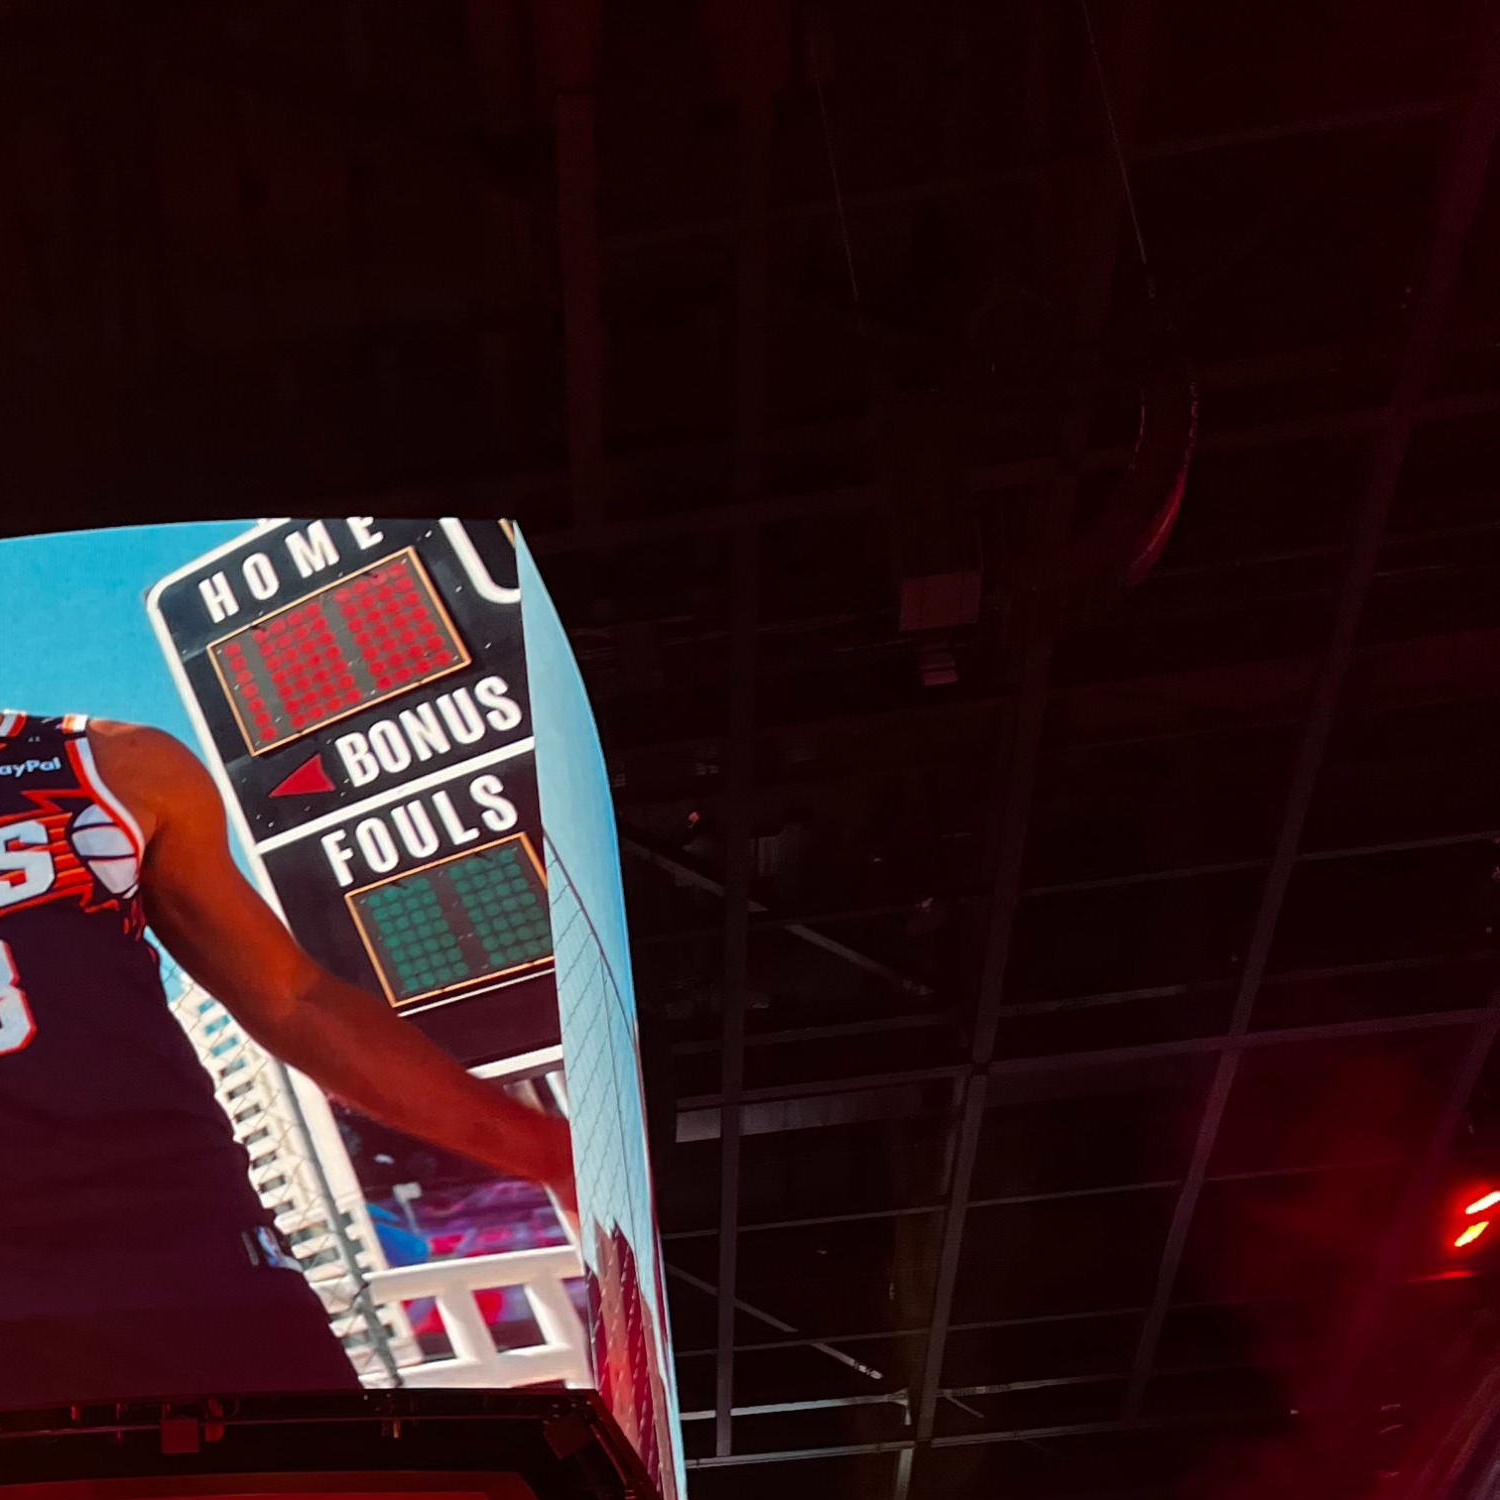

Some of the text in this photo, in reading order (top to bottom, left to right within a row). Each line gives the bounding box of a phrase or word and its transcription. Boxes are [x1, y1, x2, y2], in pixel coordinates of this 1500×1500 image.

[199, 517, 385, 623] HOME
[334, 676, 523, 788] BONUS
[321, 774, 518, 886] FOULS
